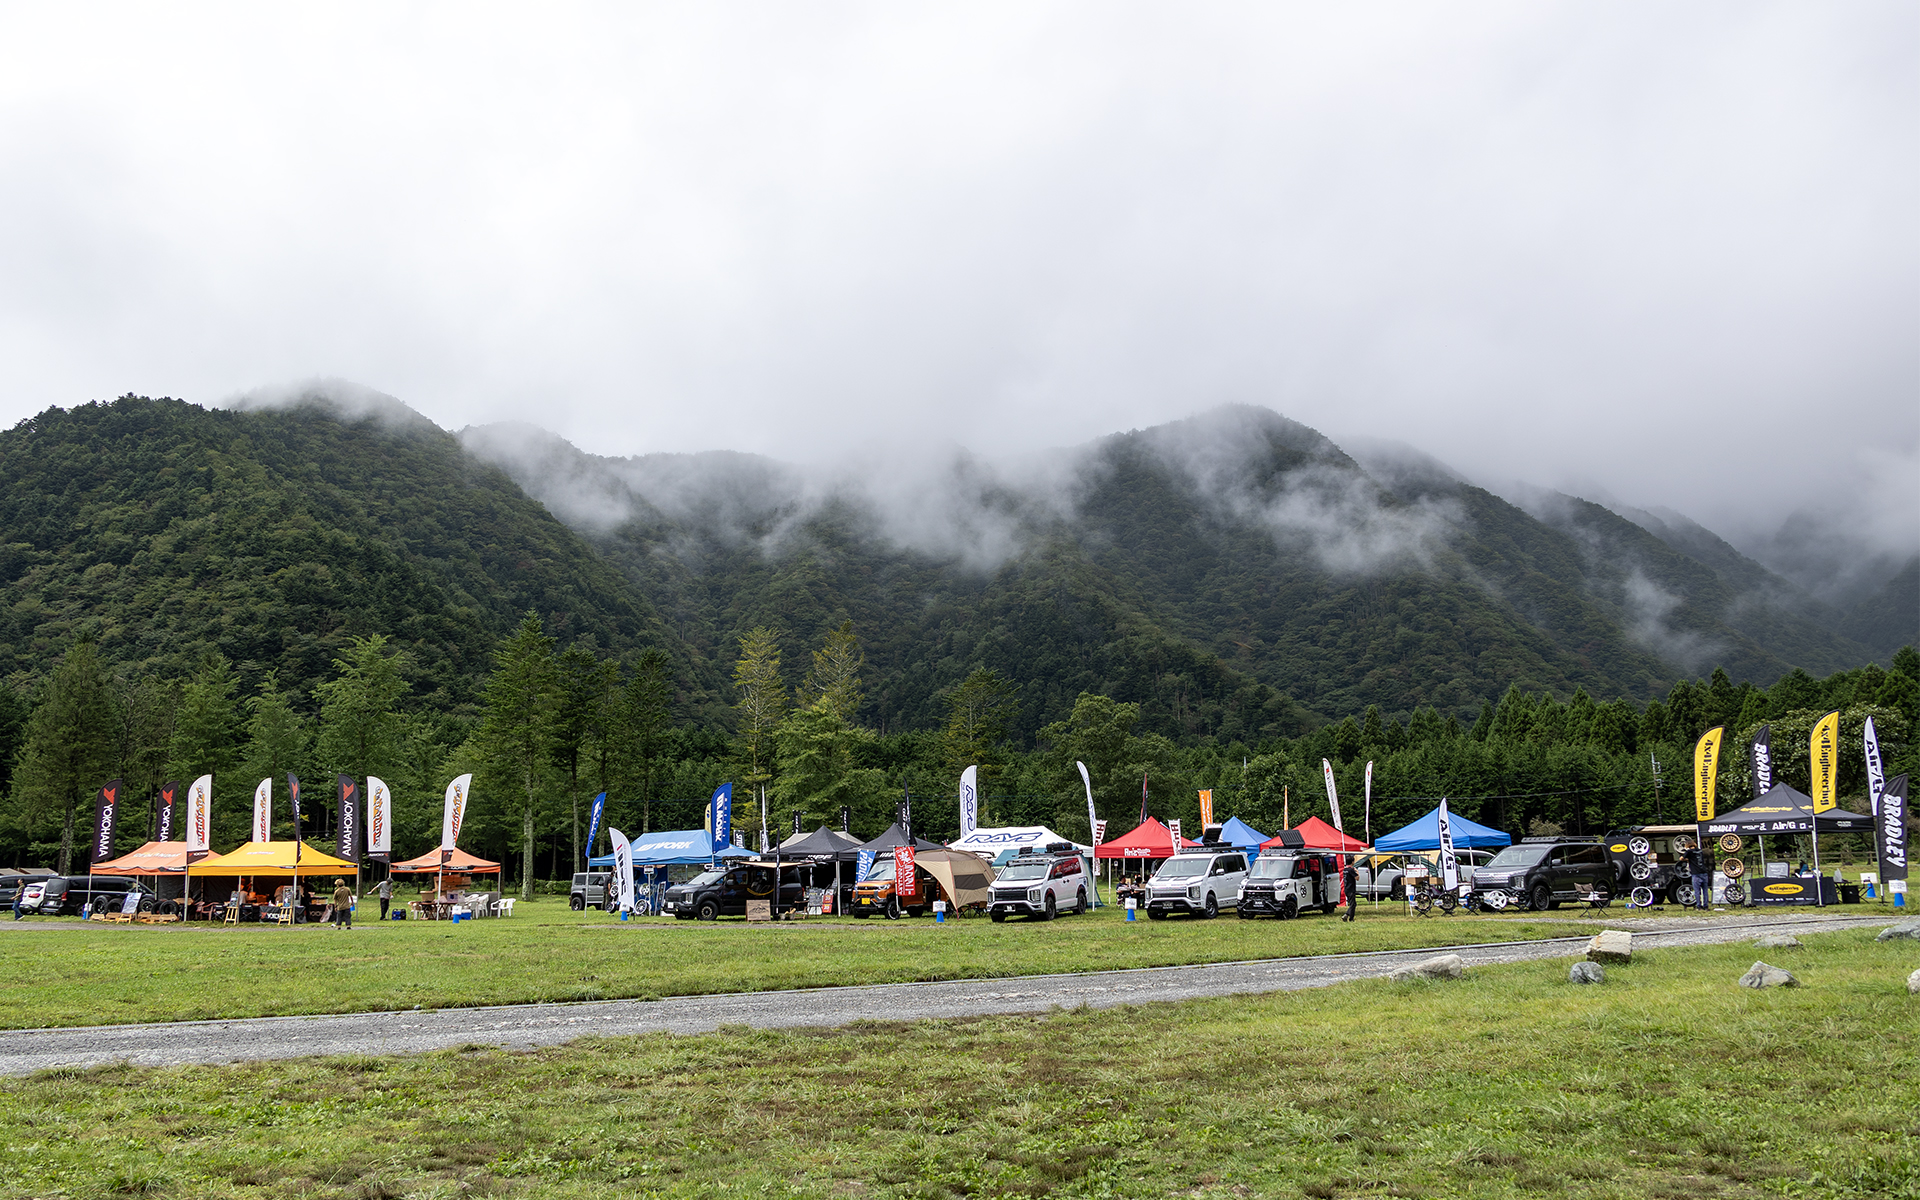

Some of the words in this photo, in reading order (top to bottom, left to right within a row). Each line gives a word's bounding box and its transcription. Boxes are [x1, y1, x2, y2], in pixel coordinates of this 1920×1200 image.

[98, 804, 114, 857] YOKOHAMA
[159, 804, 172, 842] YOKOHA
[964, 832, 1043, 844] RAYS
[1772, 821, 1796, 830] Air/G
[1883, 794, 1907, 868] BRADLEY
[651, 840, 695, 850] WORK
[1440, 818, 1455, 871] Air/G
